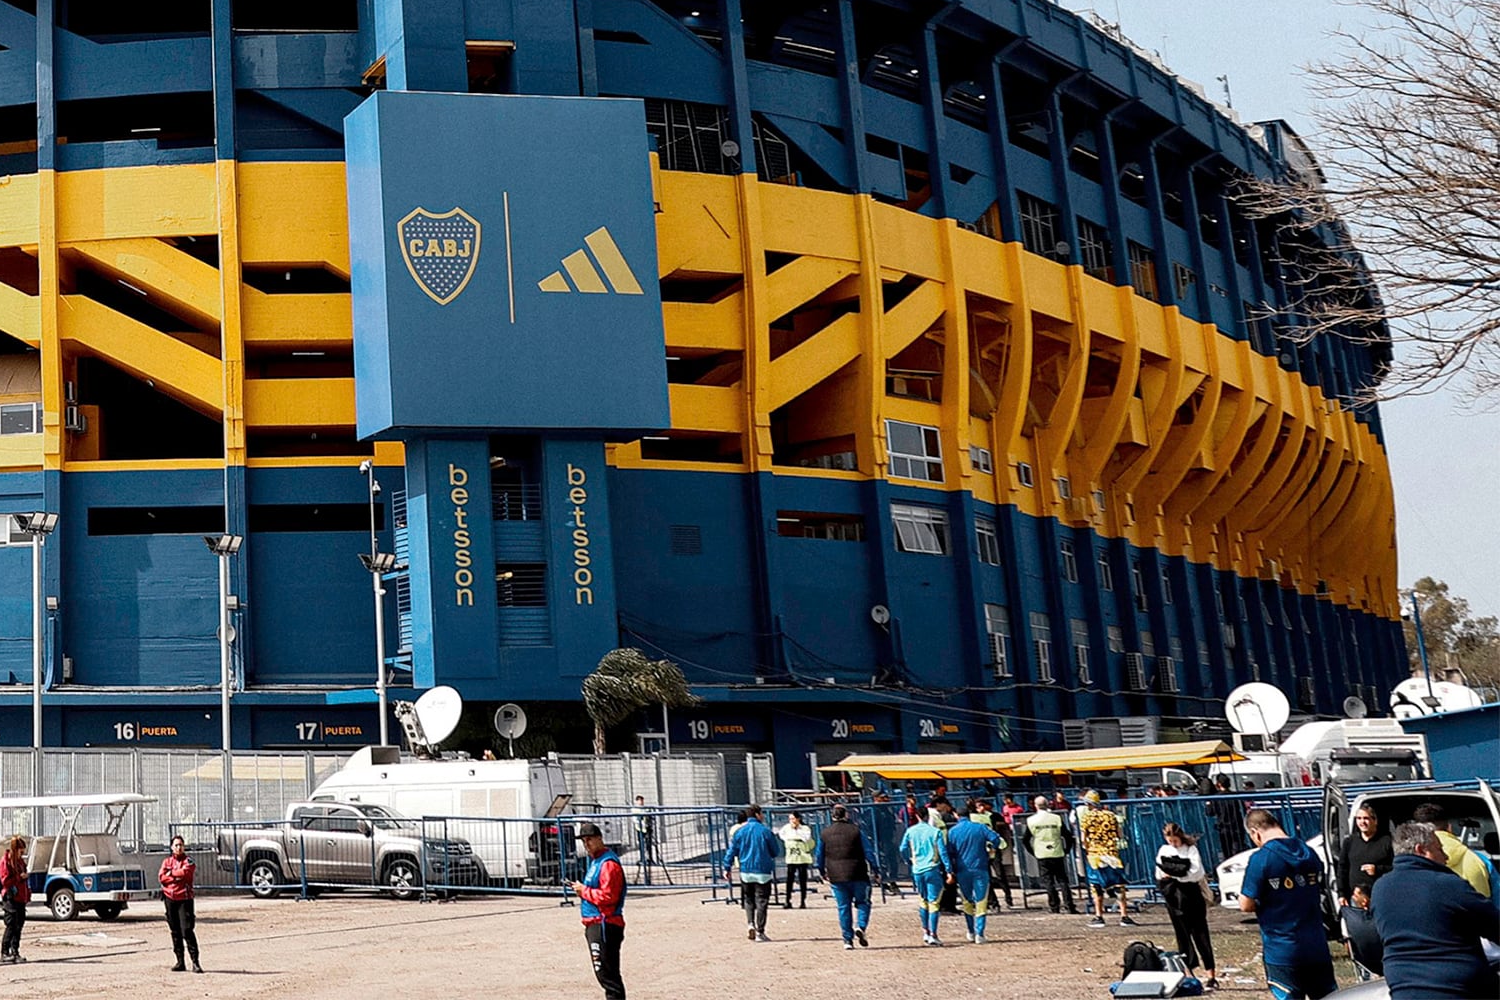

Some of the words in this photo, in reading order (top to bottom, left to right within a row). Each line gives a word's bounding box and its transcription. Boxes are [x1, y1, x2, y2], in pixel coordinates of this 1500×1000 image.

[409, 239, 471, 257] CABJ
[449, 463, 474, 606] betsson
[567, 463, 593, 605] betsson
[113, 722, 134, 740] 16
[141, 727, 178, 736] PUERTA
[295, 722, 317, 740] 17
[325, 726, 362, 736] PUERTA
[688, 719, 708, 739] 19
[831, 719, 848, 738] 20
